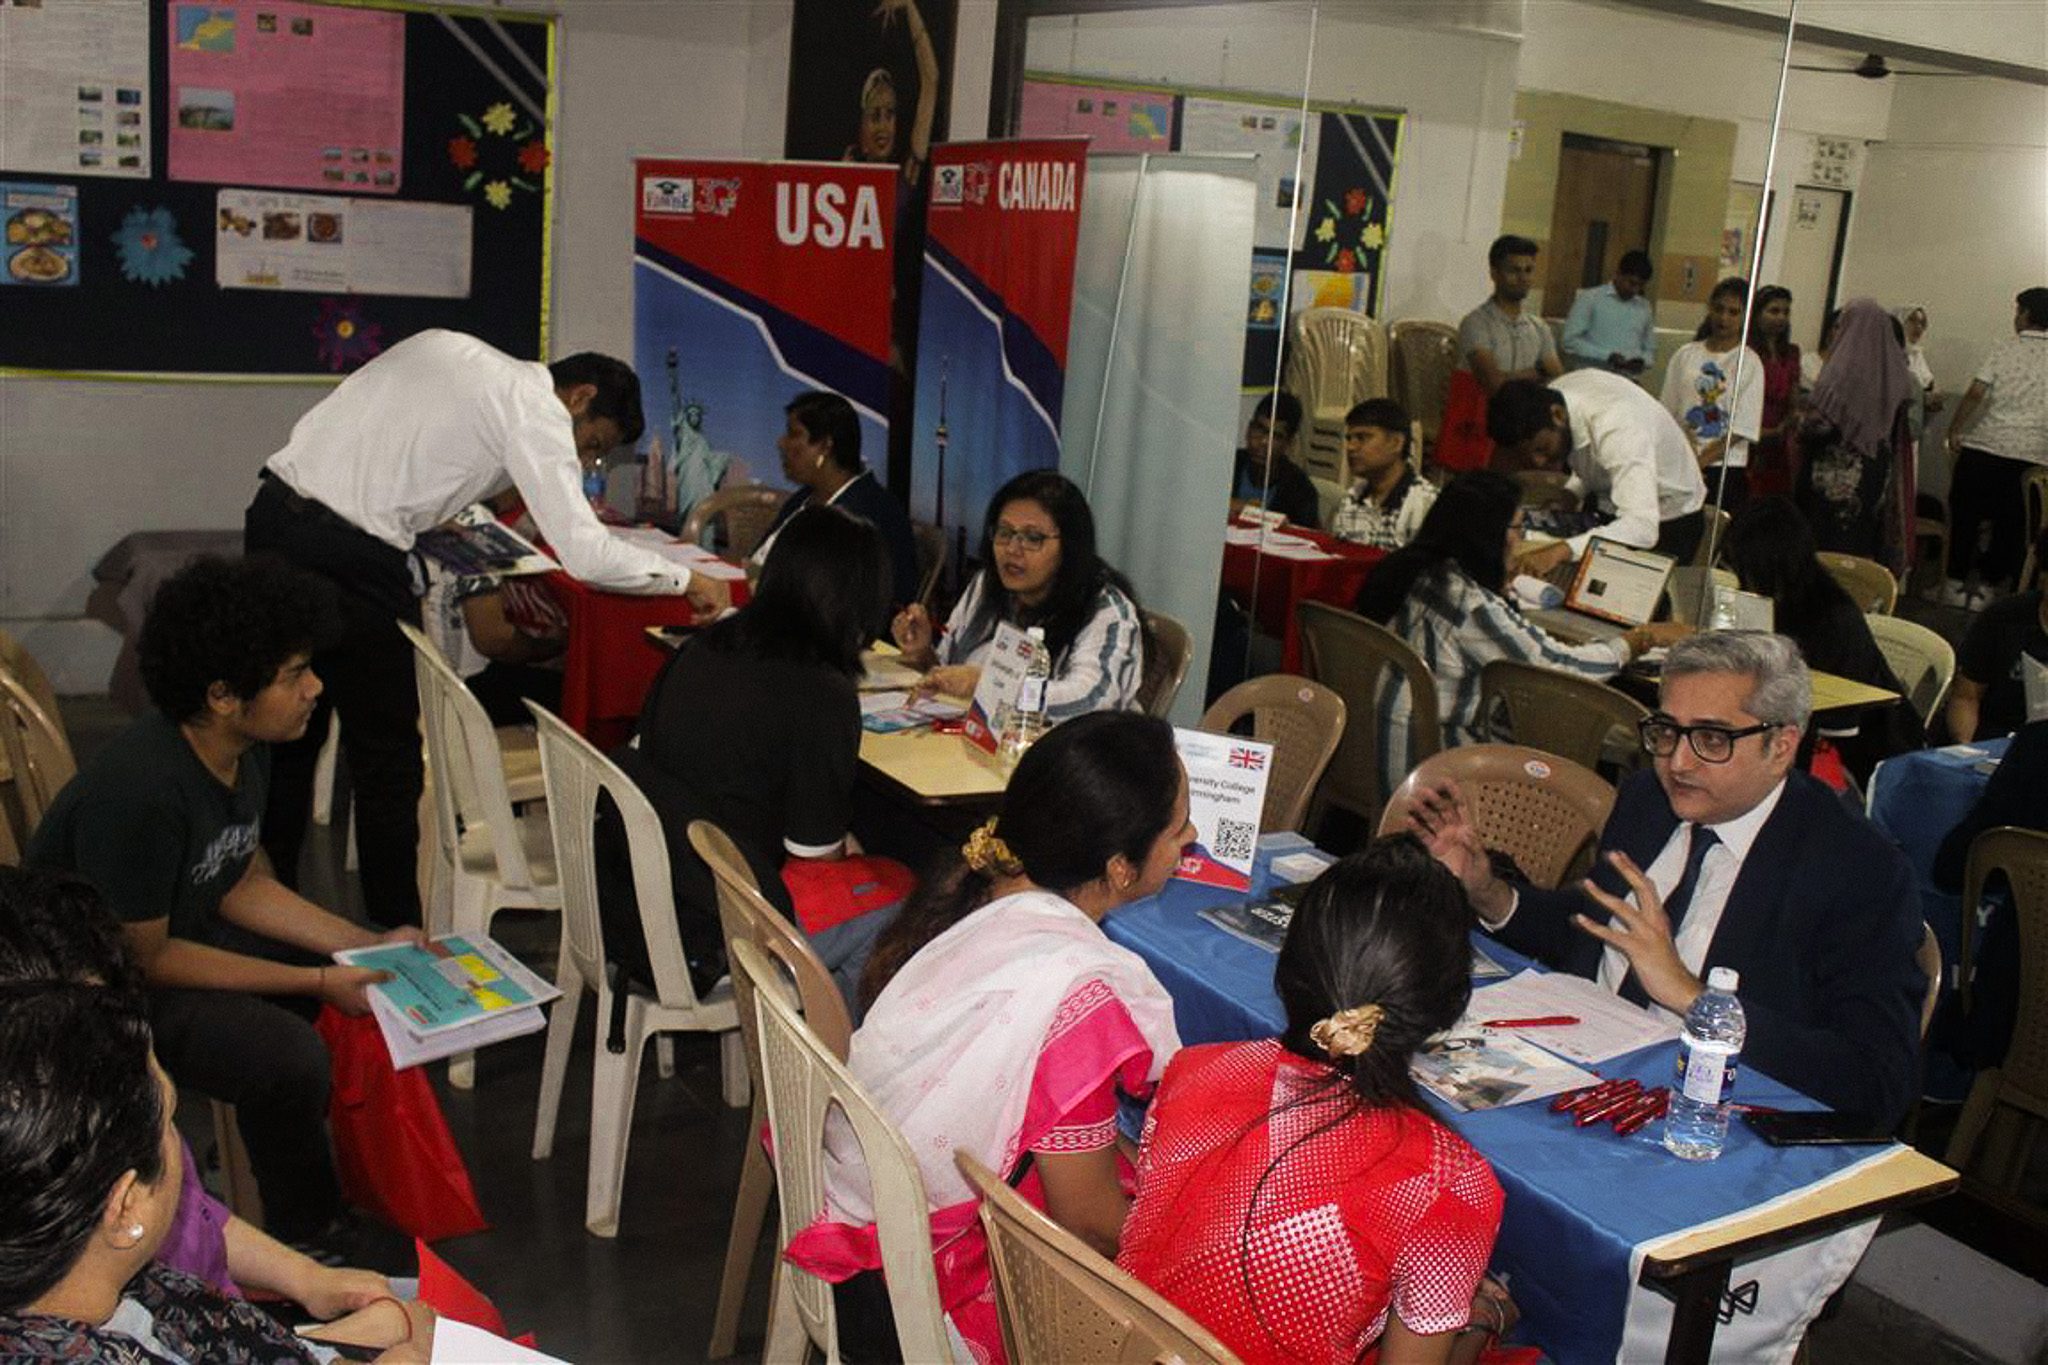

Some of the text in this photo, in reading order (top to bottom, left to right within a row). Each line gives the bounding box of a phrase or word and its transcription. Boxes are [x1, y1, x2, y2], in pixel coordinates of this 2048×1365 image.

[998, 161, 1076, 212] CANADA
[776, 182, 884, 249] USA
[1189, 776, 1255, 795] versity College
